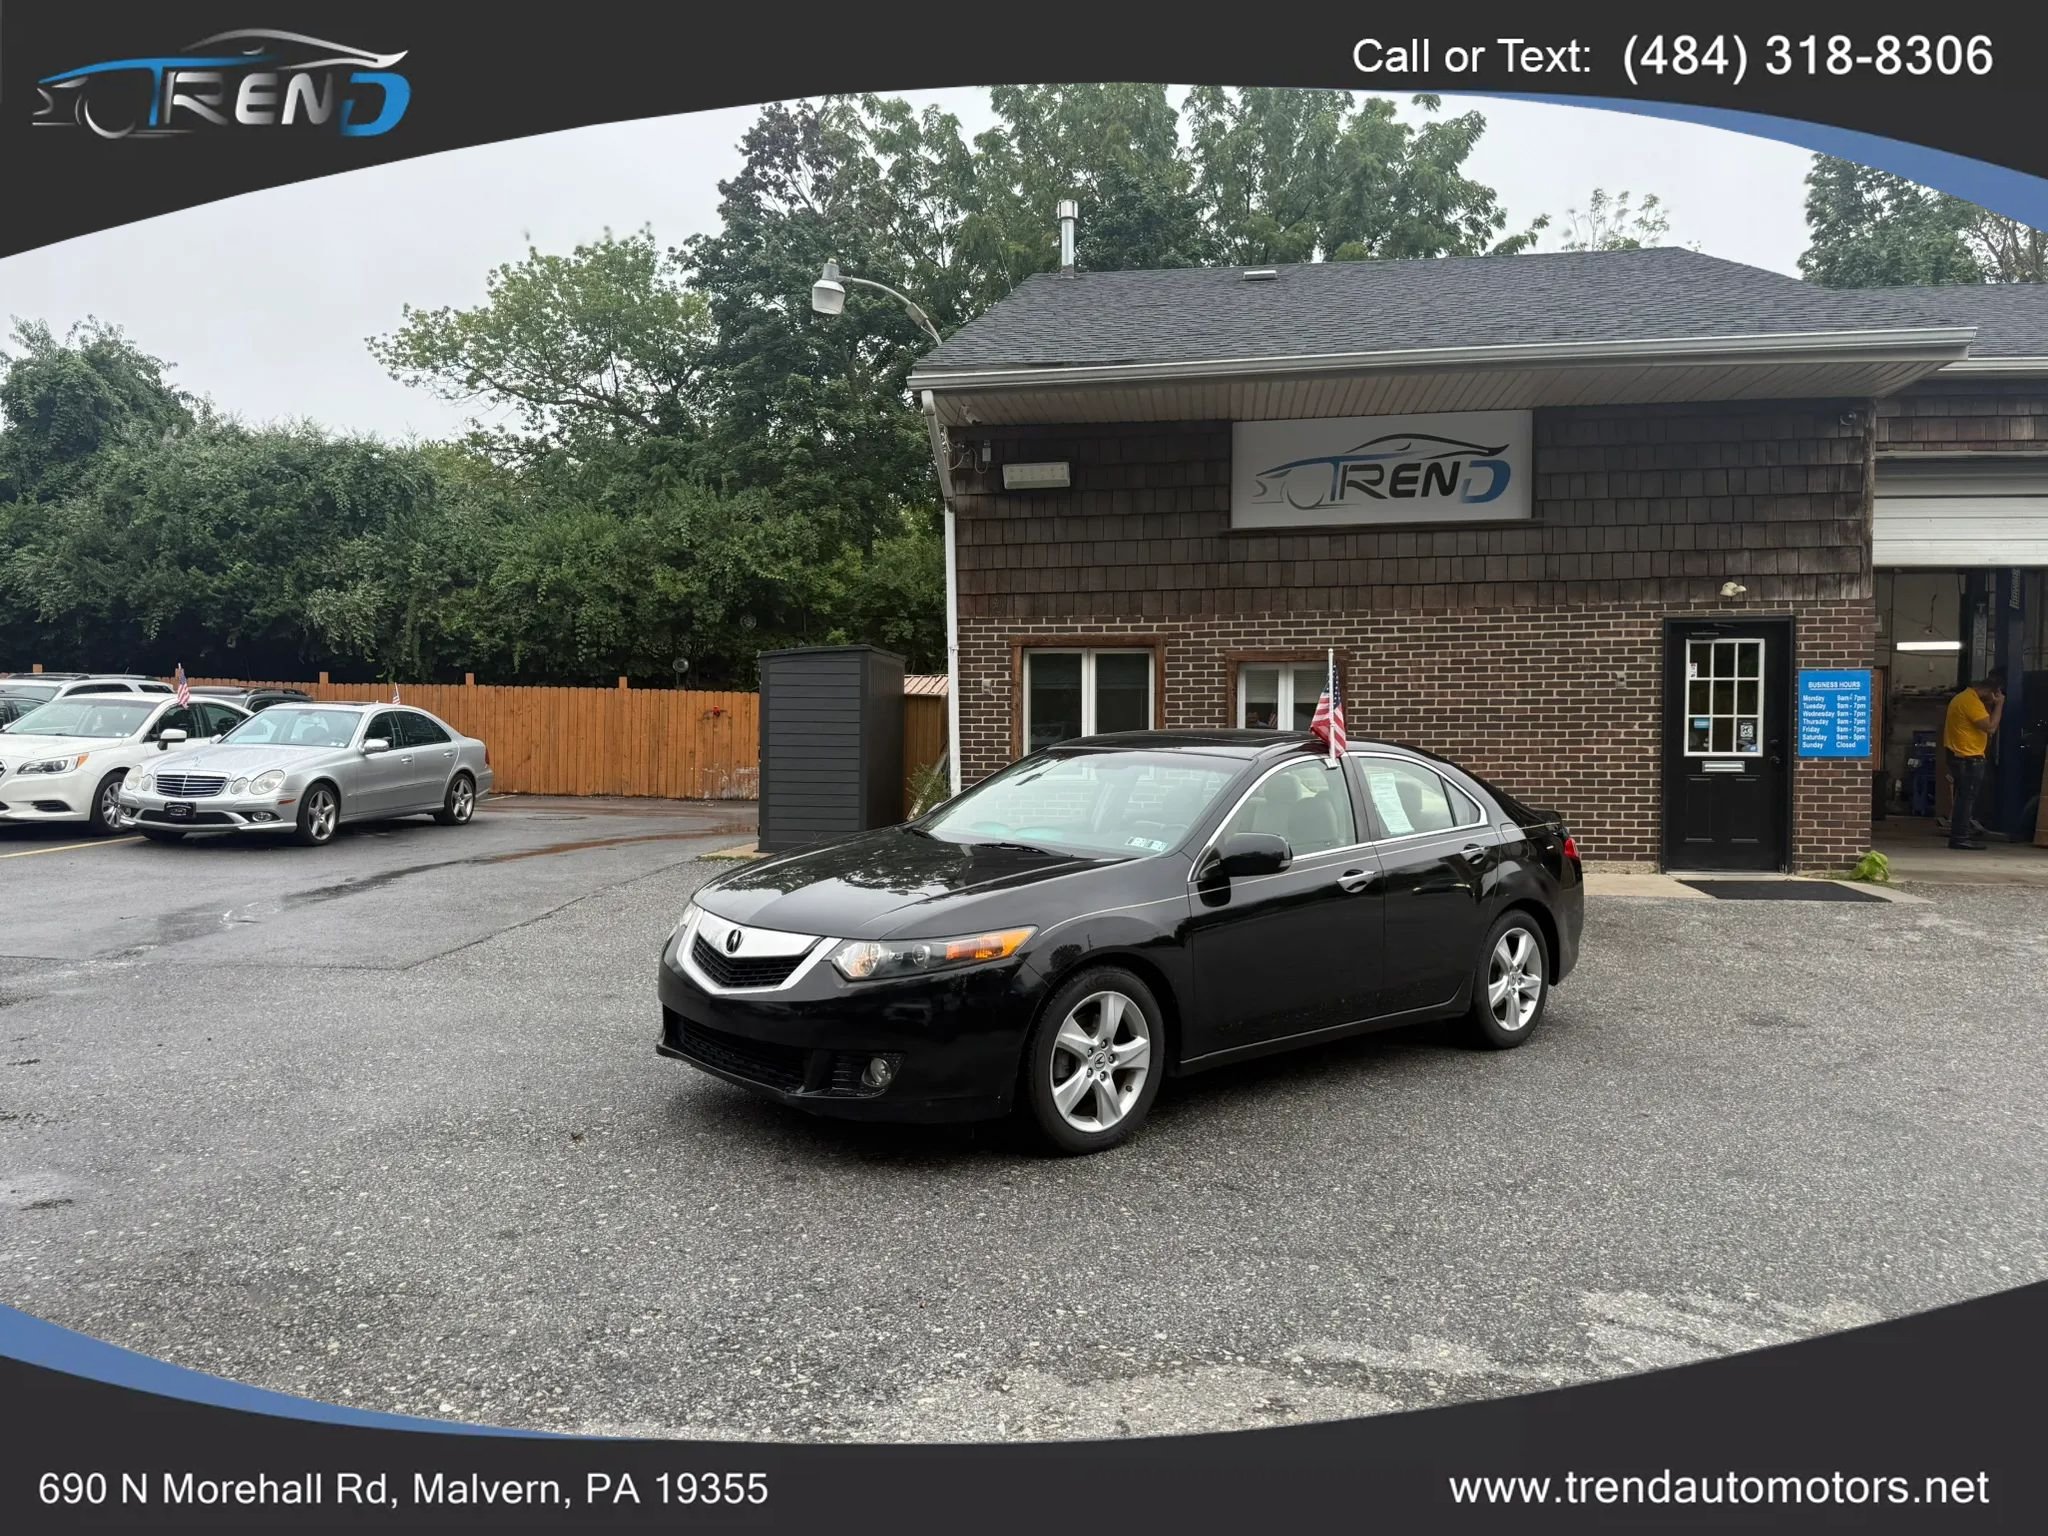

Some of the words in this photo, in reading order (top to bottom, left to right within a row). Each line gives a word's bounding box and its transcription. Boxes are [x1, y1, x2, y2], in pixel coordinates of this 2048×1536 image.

[1328, 455, 1511, 504] TREND
[1808, 681, 1838, 689] BUSINESS
[1839, 681, 1861, 689] HOURS
